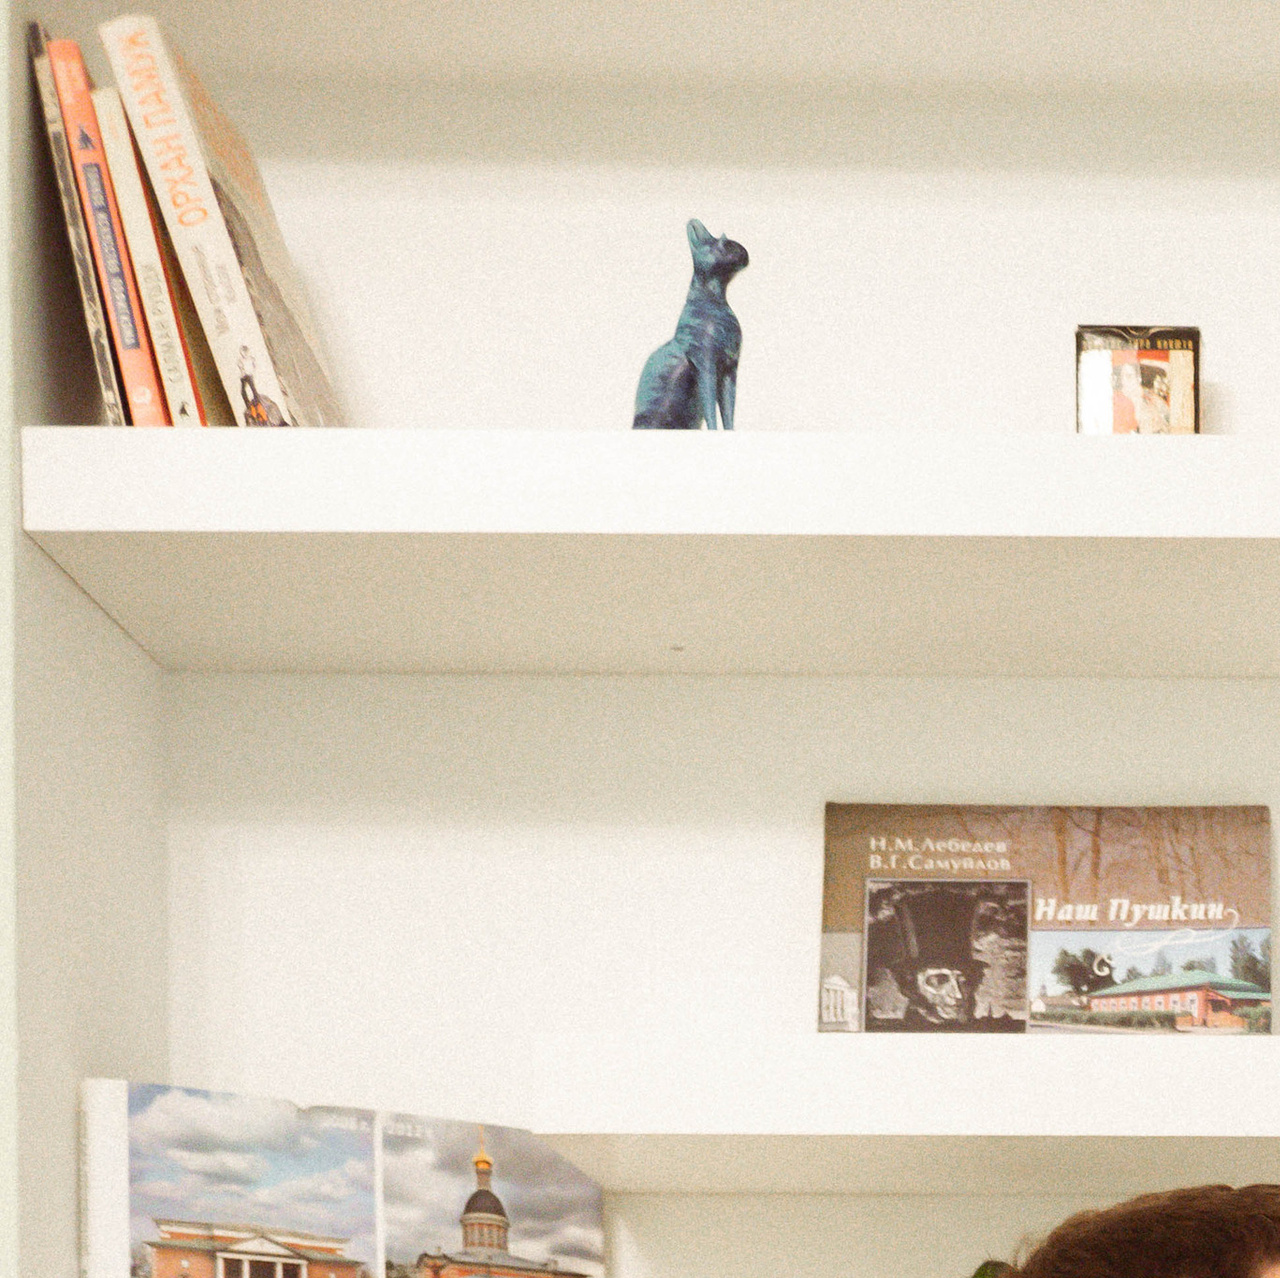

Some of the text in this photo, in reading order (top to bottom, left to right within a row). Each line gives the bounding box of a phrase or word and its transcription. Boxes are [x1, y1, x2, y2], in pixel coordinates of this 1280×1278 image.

[124, 29, 209, 228] ОРХАН ПАМУК
[1035, 896, 1226, 927] Наш Пушкин
